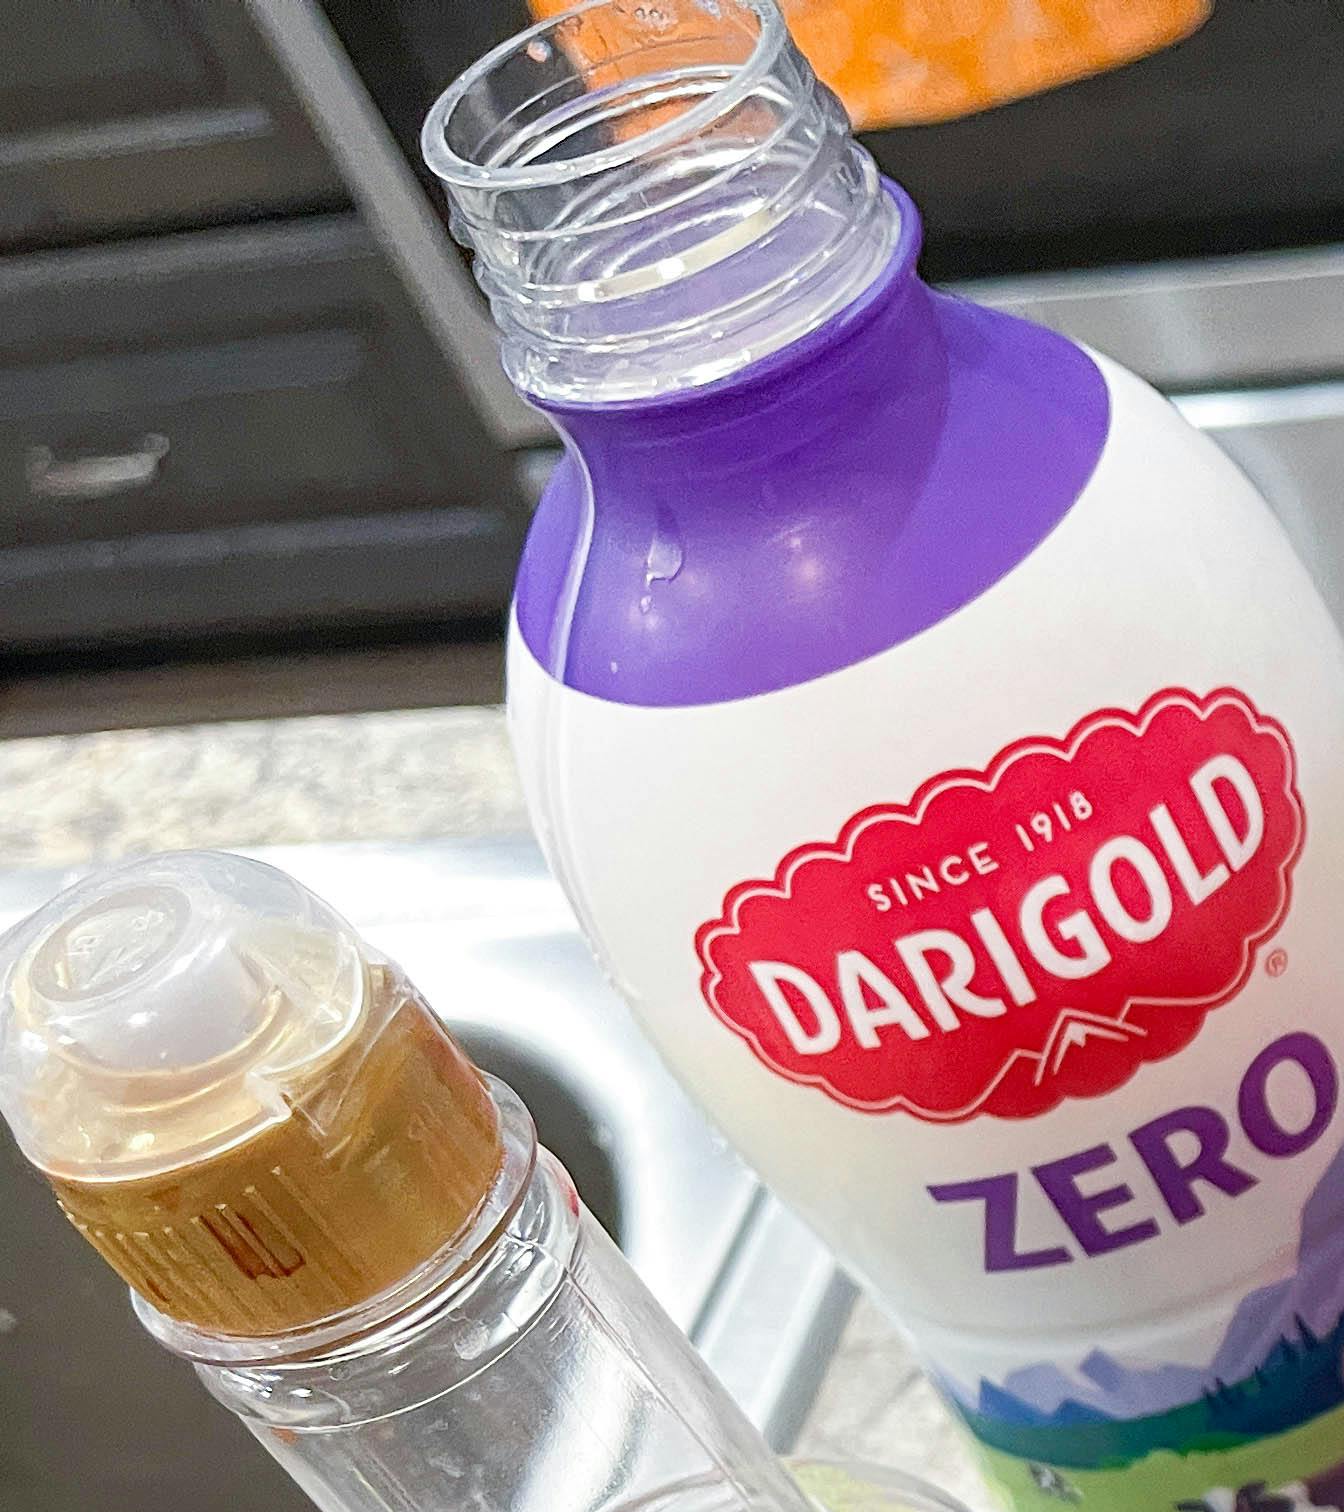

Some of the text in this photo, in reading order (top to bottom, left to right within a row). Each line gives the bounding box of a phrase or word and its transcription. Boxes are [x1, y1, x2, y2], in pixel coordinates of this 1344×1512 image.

[749, 753, 1266, 1056] DARIGOLD
[866, 790, 1093, 912] SINCE 1918
[926, 1030, 1339, 1274] ZERO
